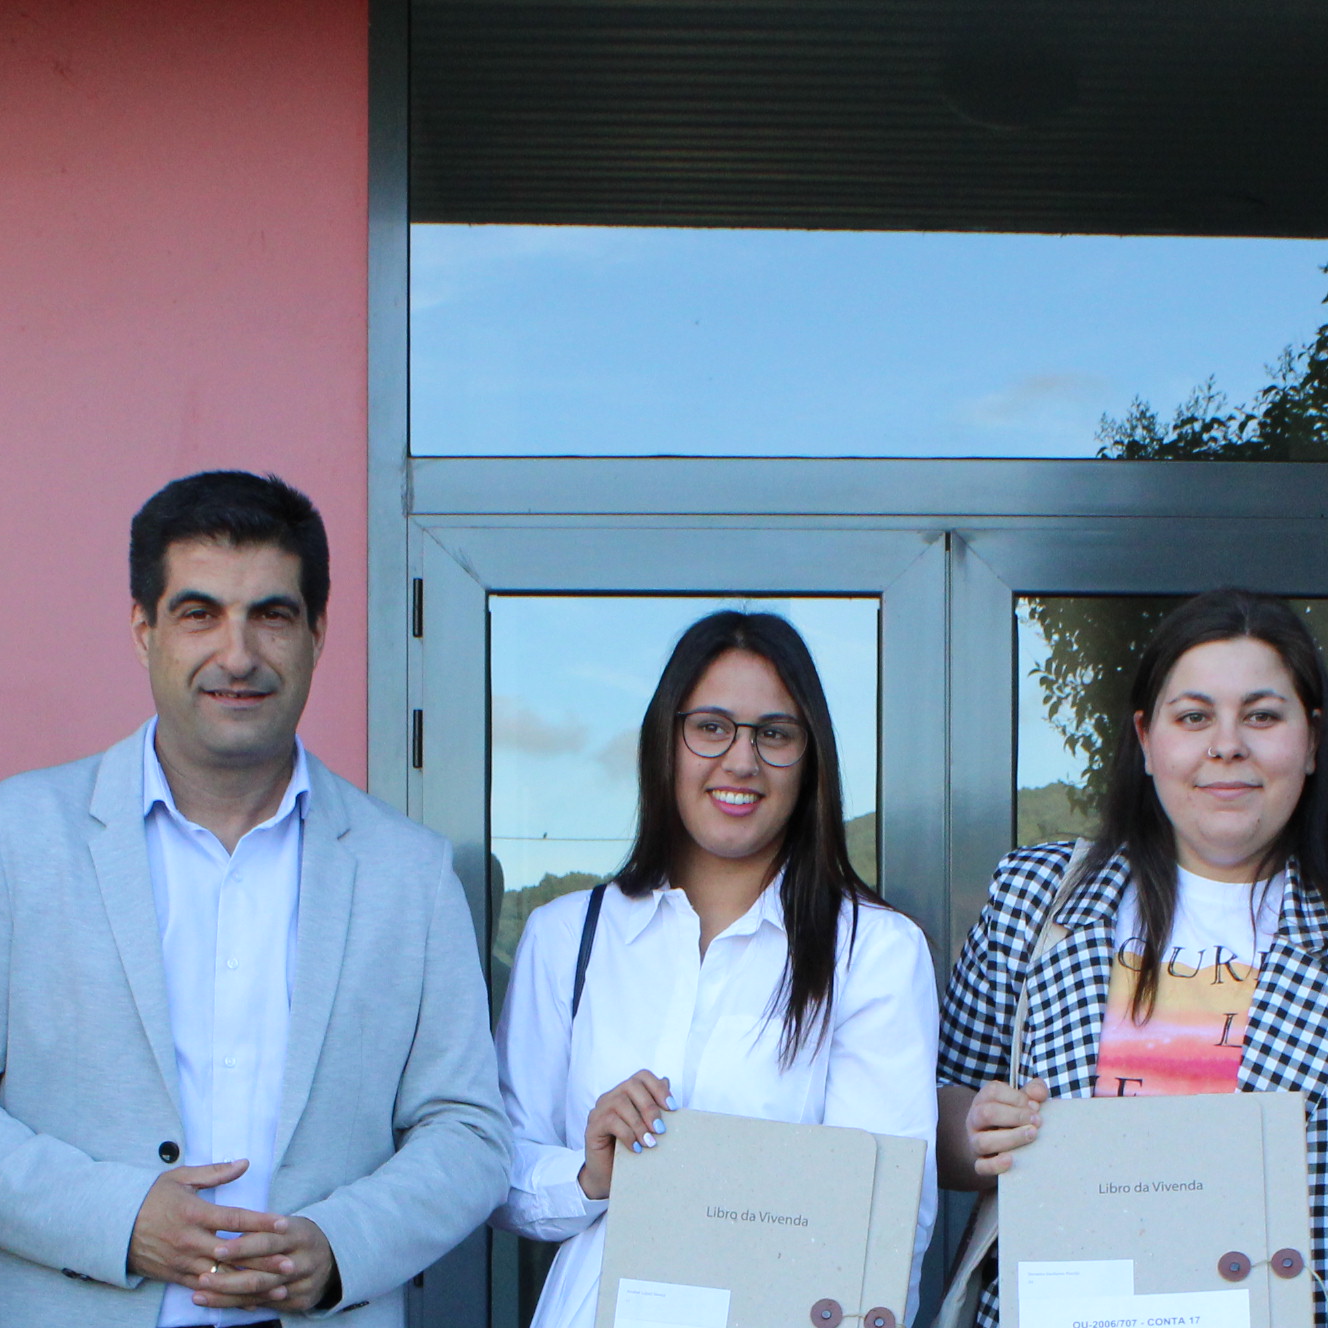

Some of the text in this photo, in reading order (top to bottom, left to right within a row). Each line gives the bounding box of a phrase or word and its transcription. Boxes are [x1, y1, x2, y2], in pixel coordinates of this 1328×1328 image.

[1098, 1179, 1204, 1195] Libro da Vivenda
[706, 1205, 809, 1227] Libro da Vivenda
[1147, 1316, 1186, 1327] CONTA
[1189, 1316, 1201, 1325] 17
